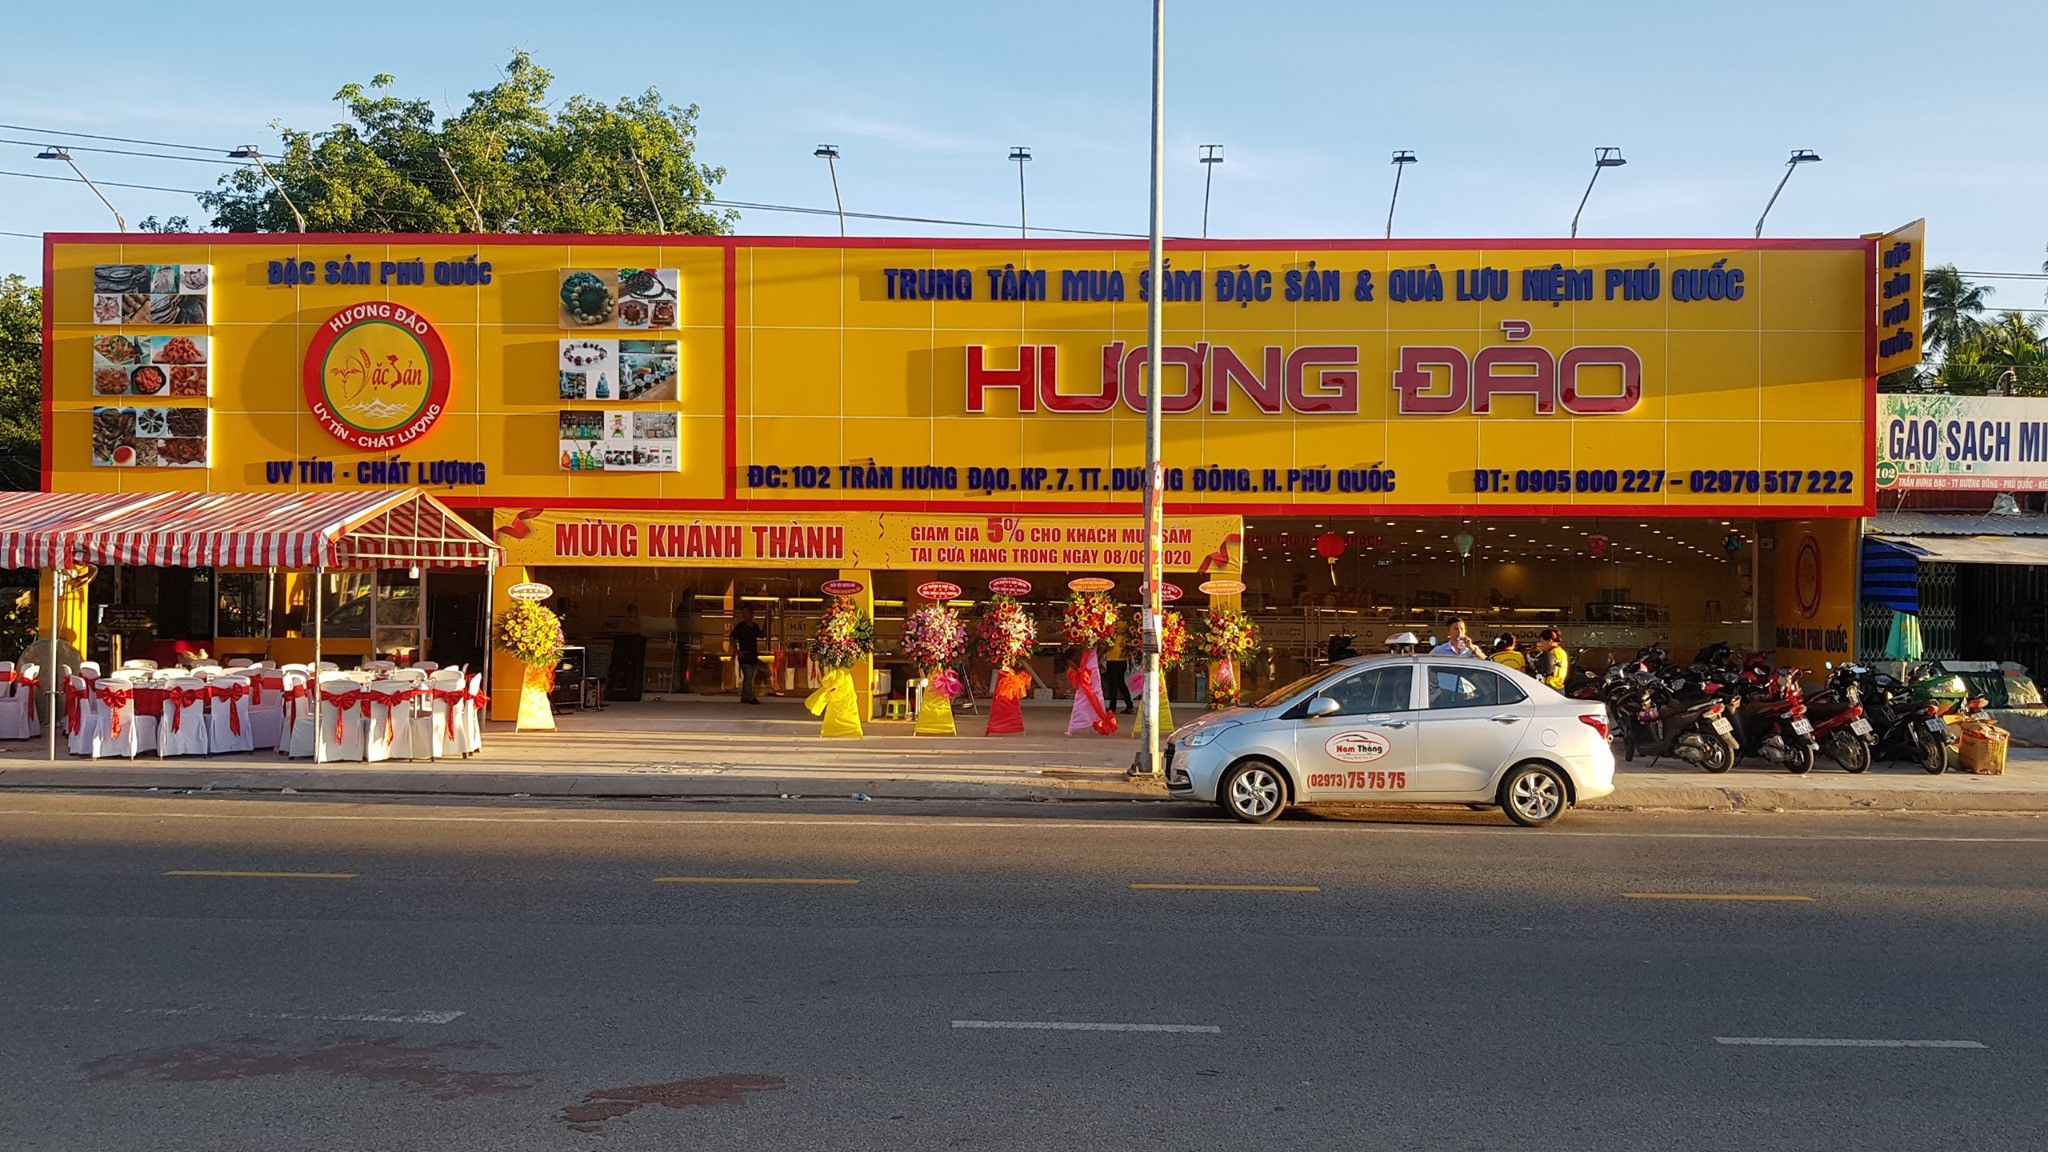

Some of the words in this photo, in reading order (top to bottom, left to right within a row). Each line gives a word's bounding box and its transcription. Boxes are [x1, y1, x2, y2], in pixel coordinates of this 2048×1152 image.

[268, 257, 315, 288] ĐẶC
[325, 254, 371, 285] SẢN
[380, 257, 425, 285] PHÚ
[434, 253, 493, 285] QUỐC
[884, 268, 972, 300] TRUNG
[987, 263, 1046, 301] TÂM
[1062, 270, 1124, 302] MUA
[1215, 263, 1272, 308] ĐẶC
[1285, 260, 1340, 302] SẢN
[1355, 269, 1374, 301] &
[1389, 263, 1443, 303] QUÀ
[1456, 266, 1508, 301] LƯU
[1523, 264, 1593, 307] NIỆM
[1606, 262, 1661, 300] PHÚ
[1673, 258, 1745, 302] QUỐC
[329, 304, 391, 333] HƯƠNG
[394, 308, 428, 335] ĐẢO
[965, 341, 1359, 414] HƯƠNG
[1393, 320, 1643, 415] ĐẢO
[313, 402, 331, 422] UY
[328, 420, 349, 441] TÍN
[398, 403, 441, 443] LƯỢNG
[1889, 419, 1938, 470] GẠO
[1946, 421, 2011, 471] SẠCH
[266, 461, 294, 484] UY
[299, 456, 334, 484] TÍN
[357, 454, 411, 484] CHẤT
[418, 459, 486, 490] LƯỢNG
[792, 466, 831, 488] 102
[839, 457, 893, 489] TRẦN
[901, 464, 957, 489] HƯNG
[967, 466, 1017, 496] ĐẠO,
[1112, 465, 1183, 491] DƯG
[1193, 464, 1258, 493] ĐÔNG,
[1288, 464, 1331, 492] PHÚ
[1338, 460, 1396, 493] QUỐC
[1475, 469, 1509, 493] ĐT:
[1515, 470, 1571, 492] 0905
[1575, 470, 1617, 492] 800
[1622, 470, 1665, 492] 227
[1764, 471, 1802, 493] 517
[1807, 471, 1853, 493] 222
[1876, 467, 1896, 479] 102
[555, 518, 638, 557] MỪNG
[648, 519, 743, 559] KHÁNH
[751, 520, 845, 560] THÀNH
[910, 524, 949, 542] GIẢM
[954, 524, 980, 542] GIÁ
[987, 517, 1025, 544] 5%
[1030, 527, 1061, 543] CHO
[1066, 525, 1118, 543] KHÁCH
[1122, 528, 1148, 543] MU
[910, 548, 933, 566] TẠI
[937, 546, 965, 563] CỬA
[970, 546, 1007, 564] HÀNG
[1012, 549, 1058, 564] TRONG
[1062, 547, 1099, 564] NGÀY
[1103, 549, 1192, 565] 08/06020
[1807, 626, 1823, 651] PHÚ
[1825, 624, 1847, 653] QUỐC
[1336, 745, 1355, 753] Nam
[1307, 773, 1347, 788] (02973)
[1347, 771, 1366, 789] 75
[1368, 771, 1386, 789] 75
[1388, 771, 1406, 789] 75
